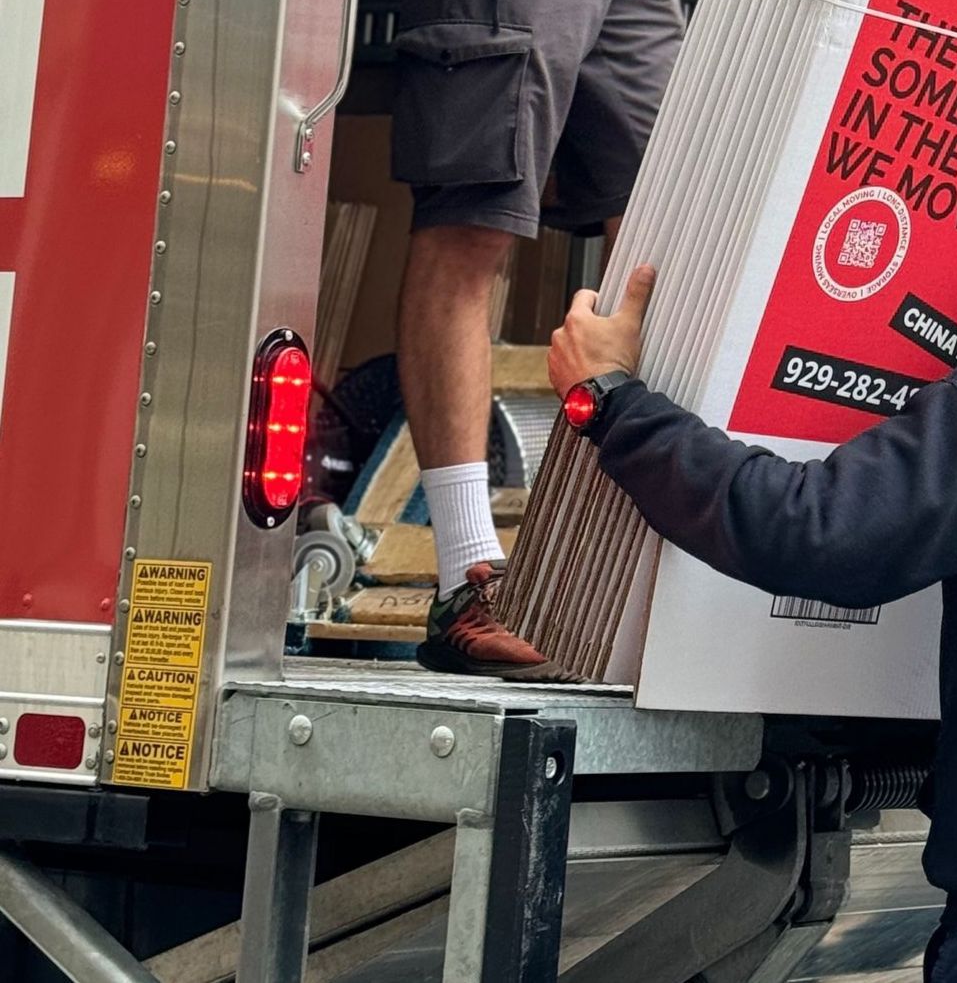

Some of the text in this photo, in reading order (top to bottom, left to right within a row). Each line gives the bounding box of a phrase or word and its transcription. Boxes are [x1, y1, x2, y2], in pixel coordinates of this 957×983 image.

[840, 89, 892, 141] IN
[826, 131, 895, 187] WE
[842, 190, 875, 209] MOVING
[883, 192, 901, 210] LONG
[821, 207, 843, 234] LOCAL
[898, 208, 908, 250] DISTANCE
[867, 262, 899, 294] STORAGE
[904, 308, 957, 356] CHINA
[783, 357, 920, 411] 929-282-4
[149, 567, 205, 581] WARNING
[144, 609, 201, 626] WARNING
[138, 670, 195, 684] CAUTION
[139, 709, 183, 723] NOTICE
[131, 742, 185, 759] NOTICE
